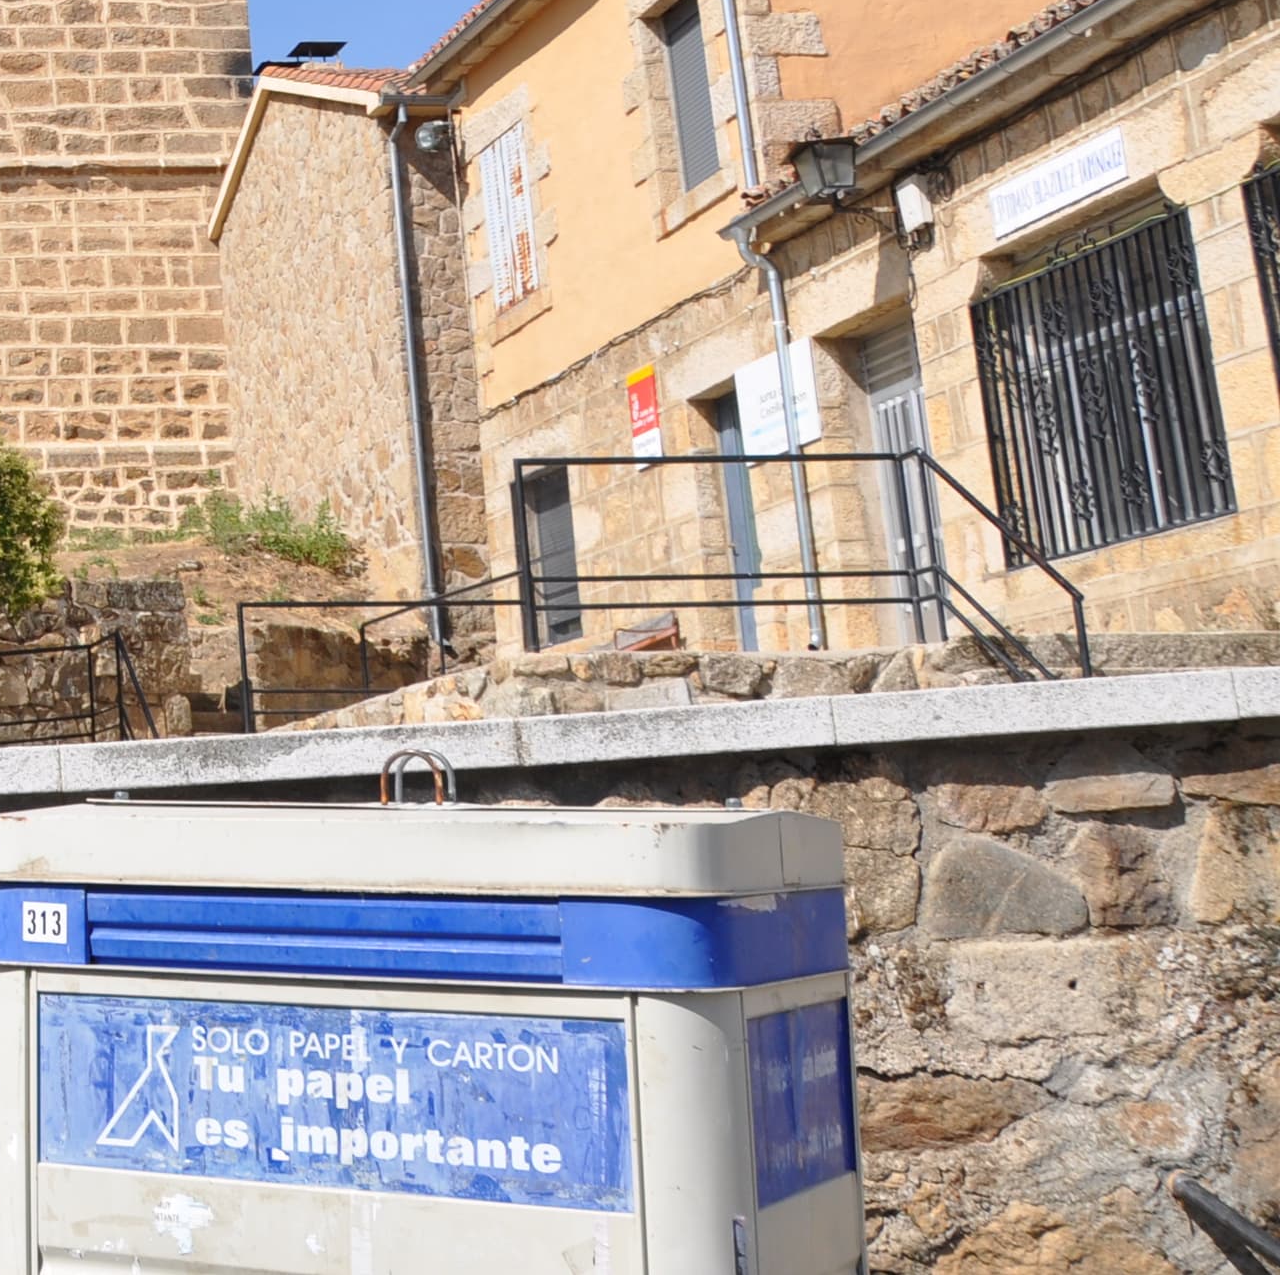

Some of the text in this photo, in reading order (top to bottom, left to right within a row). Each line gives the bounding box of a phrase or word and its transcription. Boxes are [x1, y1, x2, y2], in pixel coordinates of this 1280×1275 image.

[28, 909, 61, 936] 313
[192, 1027, 559, 1074] SOLO PAPEL Y CARTON
[194, 1055, 411, 1110] Tu papel
[195, 1116, 562, 1174] es importante
